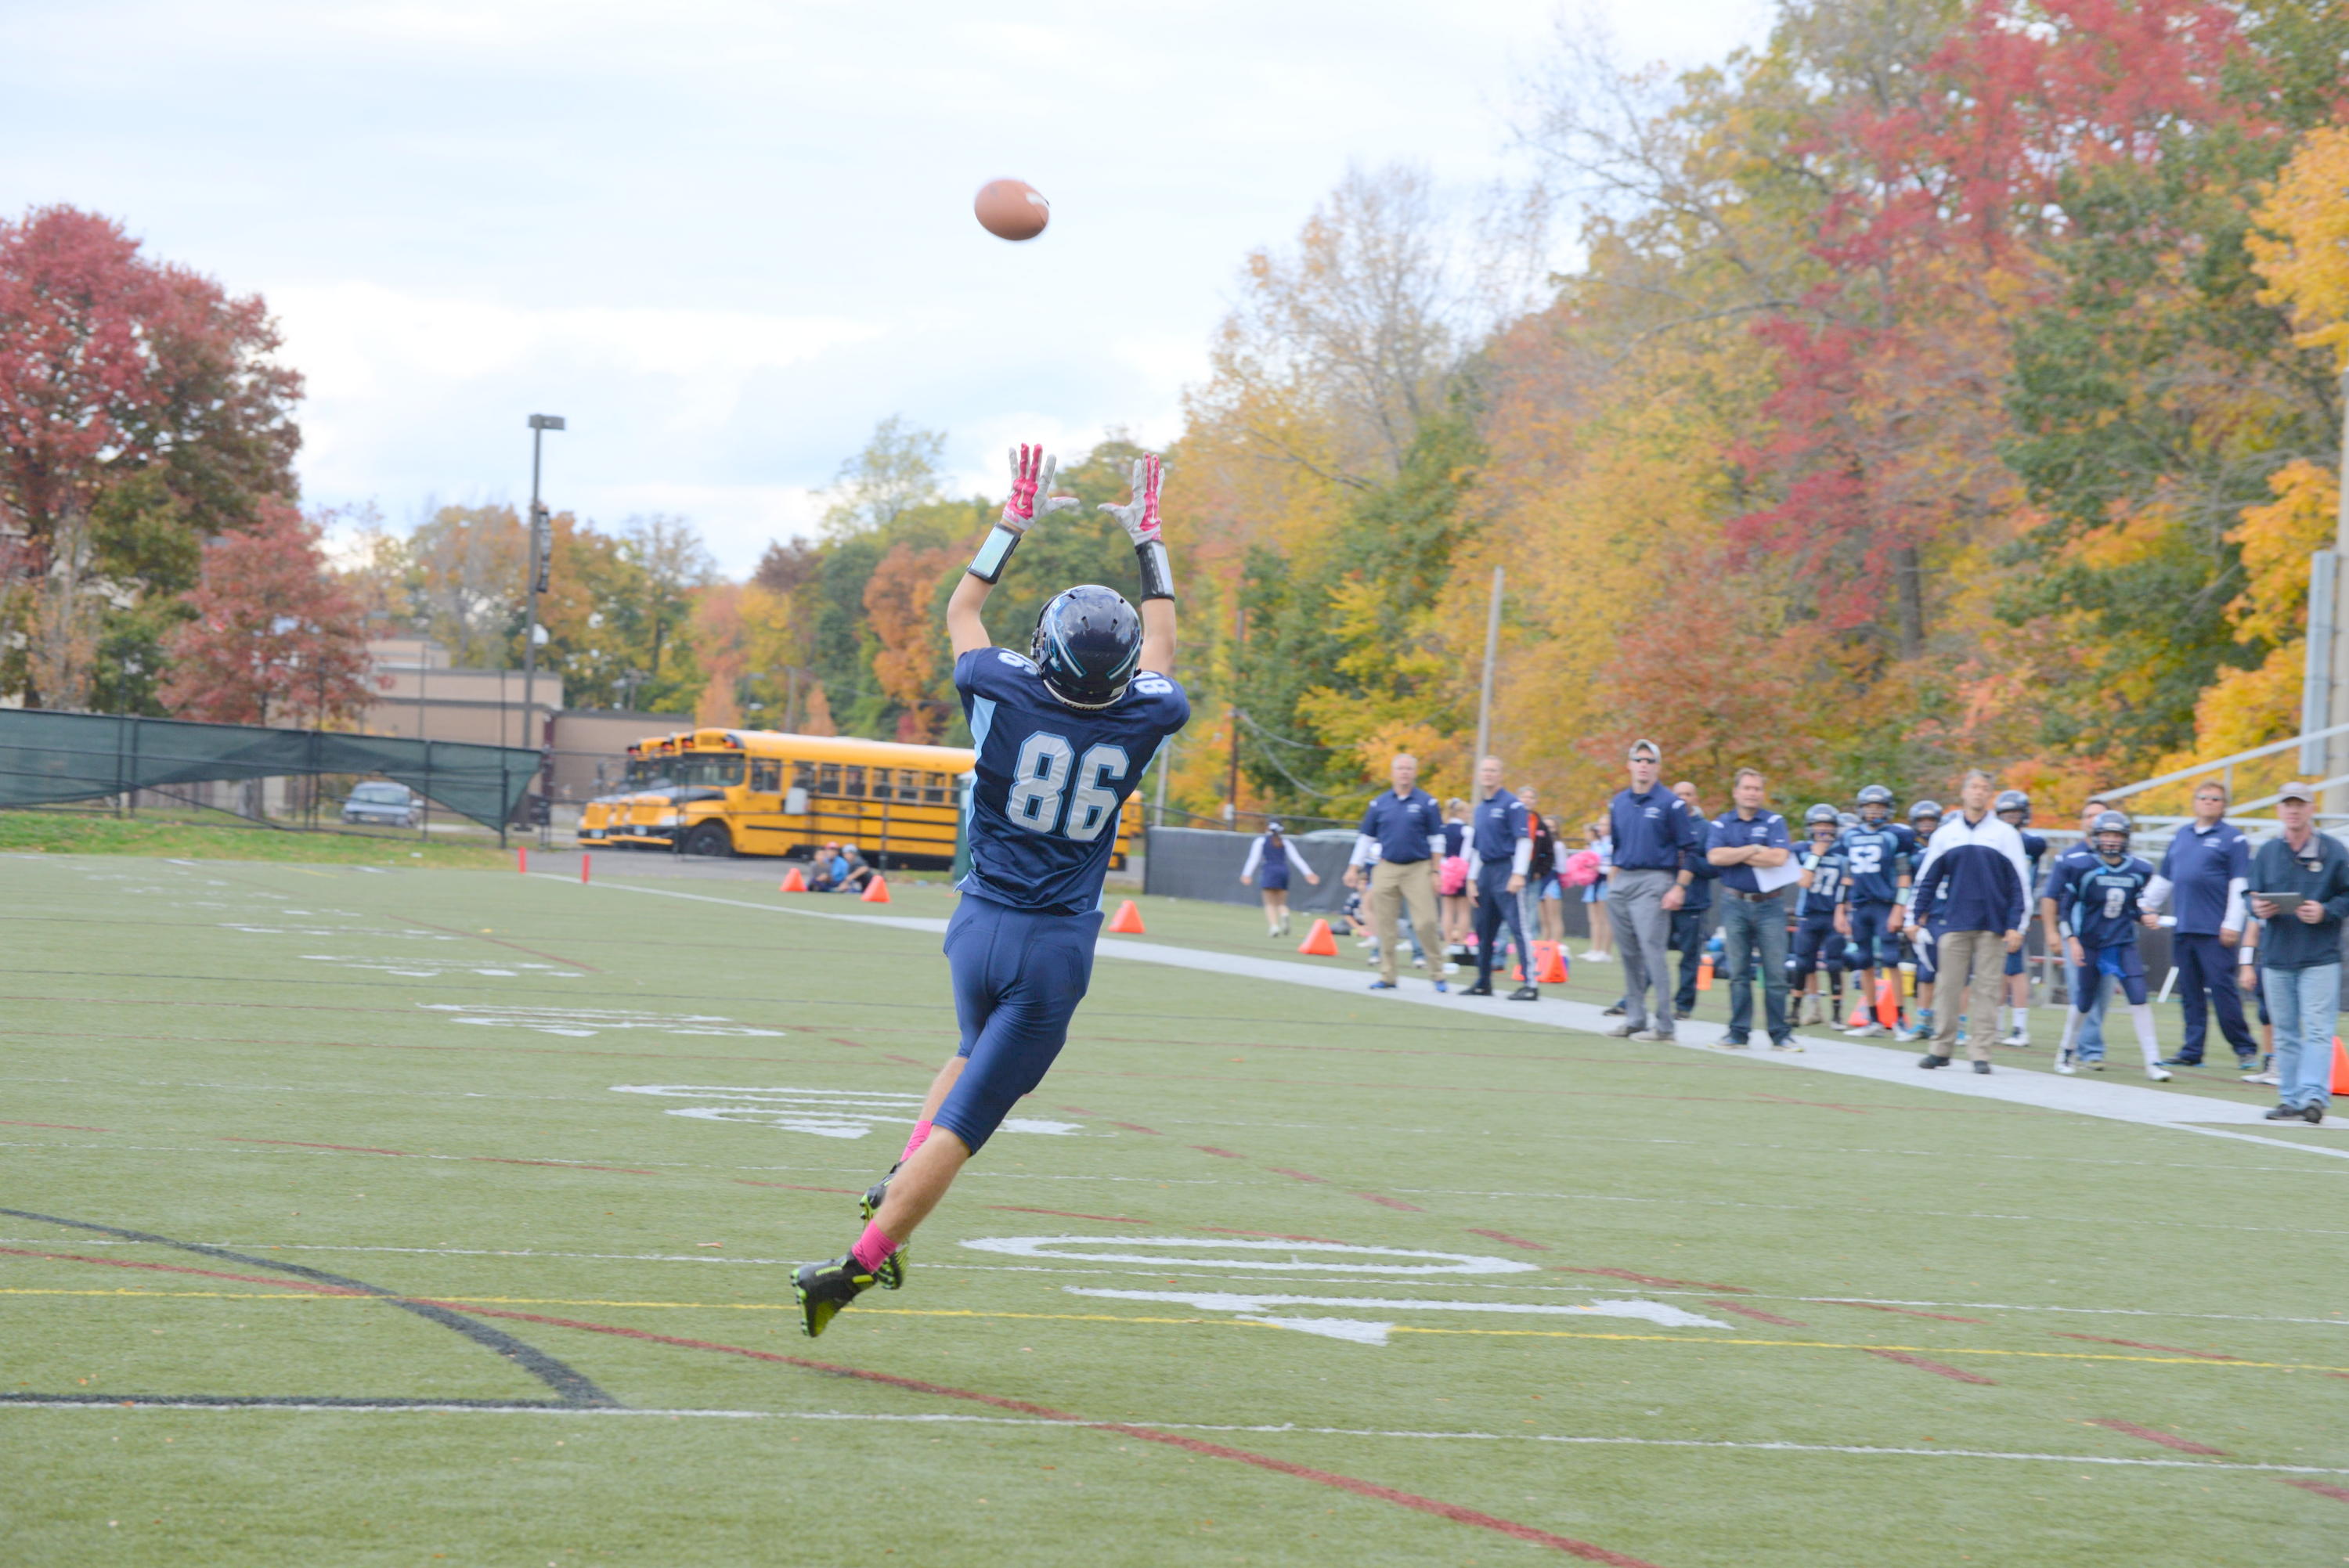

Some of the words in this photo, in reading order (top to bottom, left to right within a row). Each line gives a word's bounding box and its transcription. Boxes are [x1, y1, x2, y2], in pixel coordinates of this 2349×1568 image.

[1005, 730, 1130, 842] 86
[1848, 845, 1882, 874] 52
[2103, 887, 2126, 919] 8
